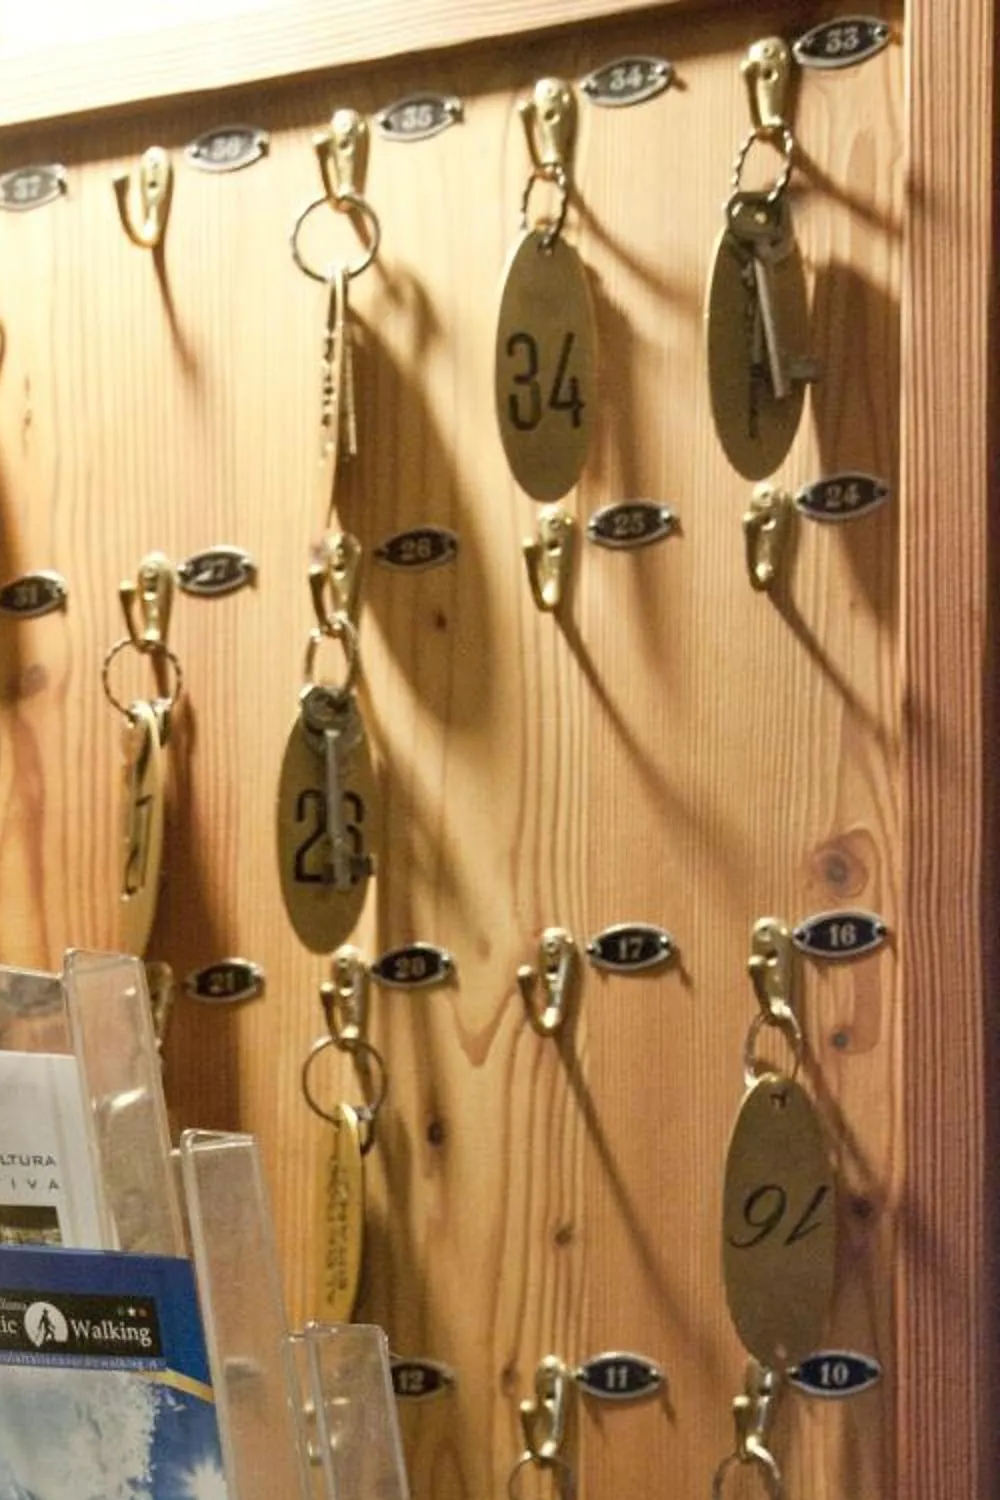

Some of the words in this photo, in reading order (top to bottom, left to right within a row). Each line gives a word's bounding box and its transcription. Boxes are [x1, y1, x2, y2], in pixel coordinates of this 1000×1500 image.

[825, 27, 859, 52] 33
[609, 69, 643, 92] 34
[506, 332, 587, 431] 34
[827, 484, 860, 507] 24
[828, 924, 856, 946] 16
[617, 937, 644, 959] 17
[69, 1319, 153, 1348] Walking
[398, 1370, 425, 1392] 12
[604, 1366, 629, 1388] 11
[819, 1362, 848, 1385] 10
